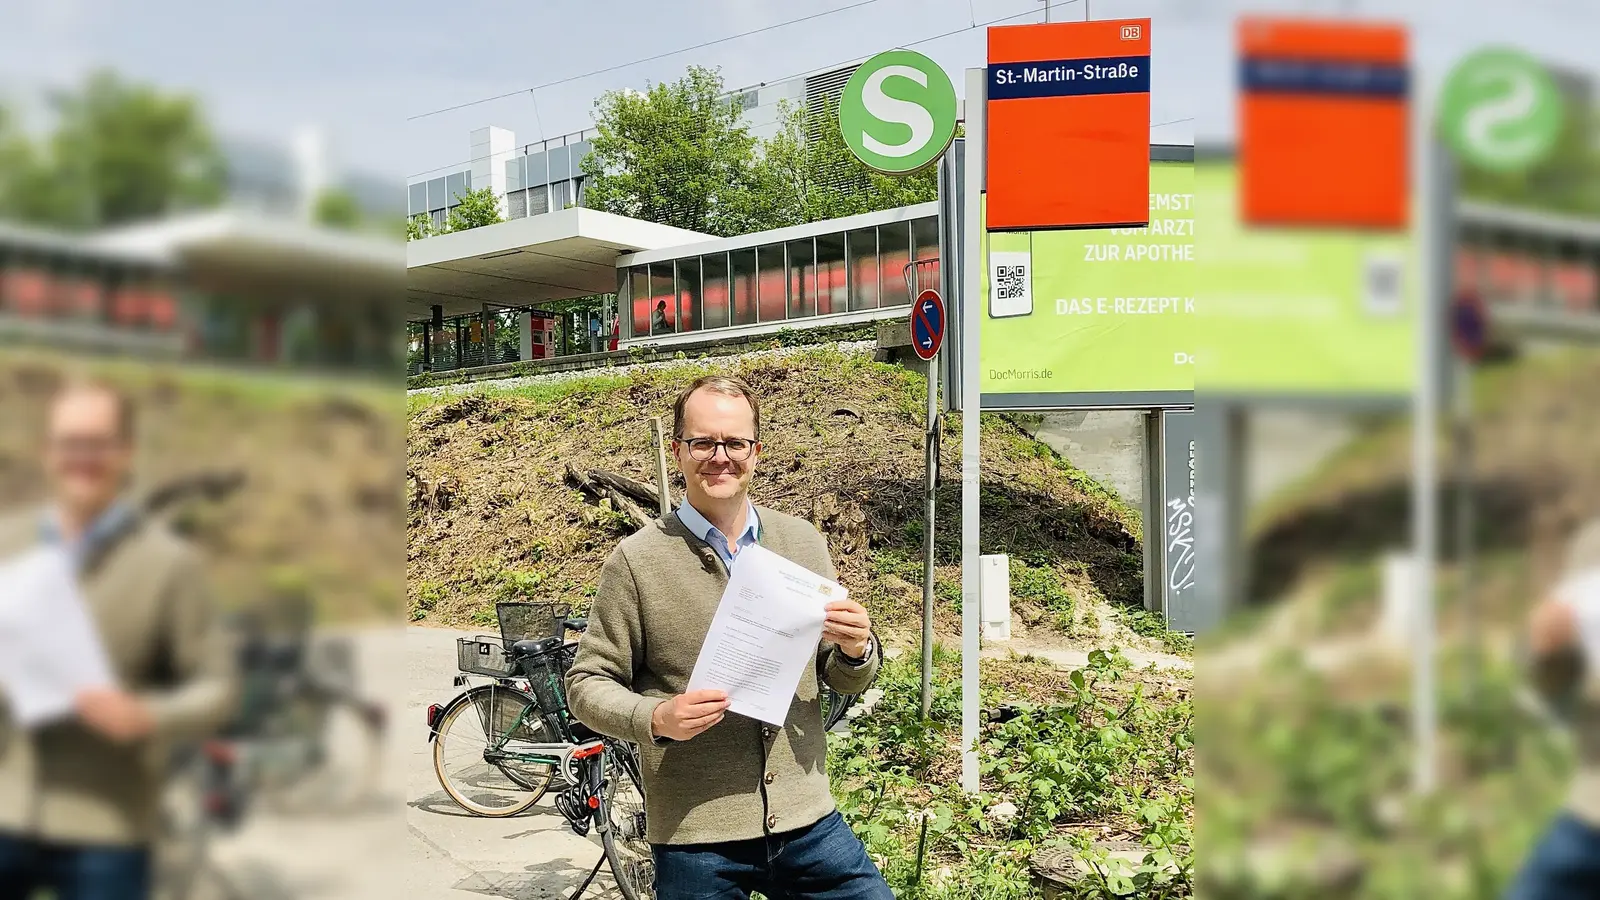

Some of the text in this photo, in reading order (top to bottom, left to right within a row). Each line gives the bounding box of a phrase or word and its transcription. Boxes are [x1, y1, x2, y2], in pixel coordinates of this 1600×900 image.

[1121, 26, 1140, 39] DB
[996, 63, 1139, 85] St.-Martin-Straße
[861, 65, 935, 158] S
[1148, 193, 1194, 211] EMST
[1151, 218, 1194, 236] ARZT
[1084, 243, 1194, 262] ZUR APOTHE
[1056, 298, 1092, 315] DAS
[1097, 297, 1180, 315] E-REZEPT
[989, 368, 1053, 380] DocMorris.de
